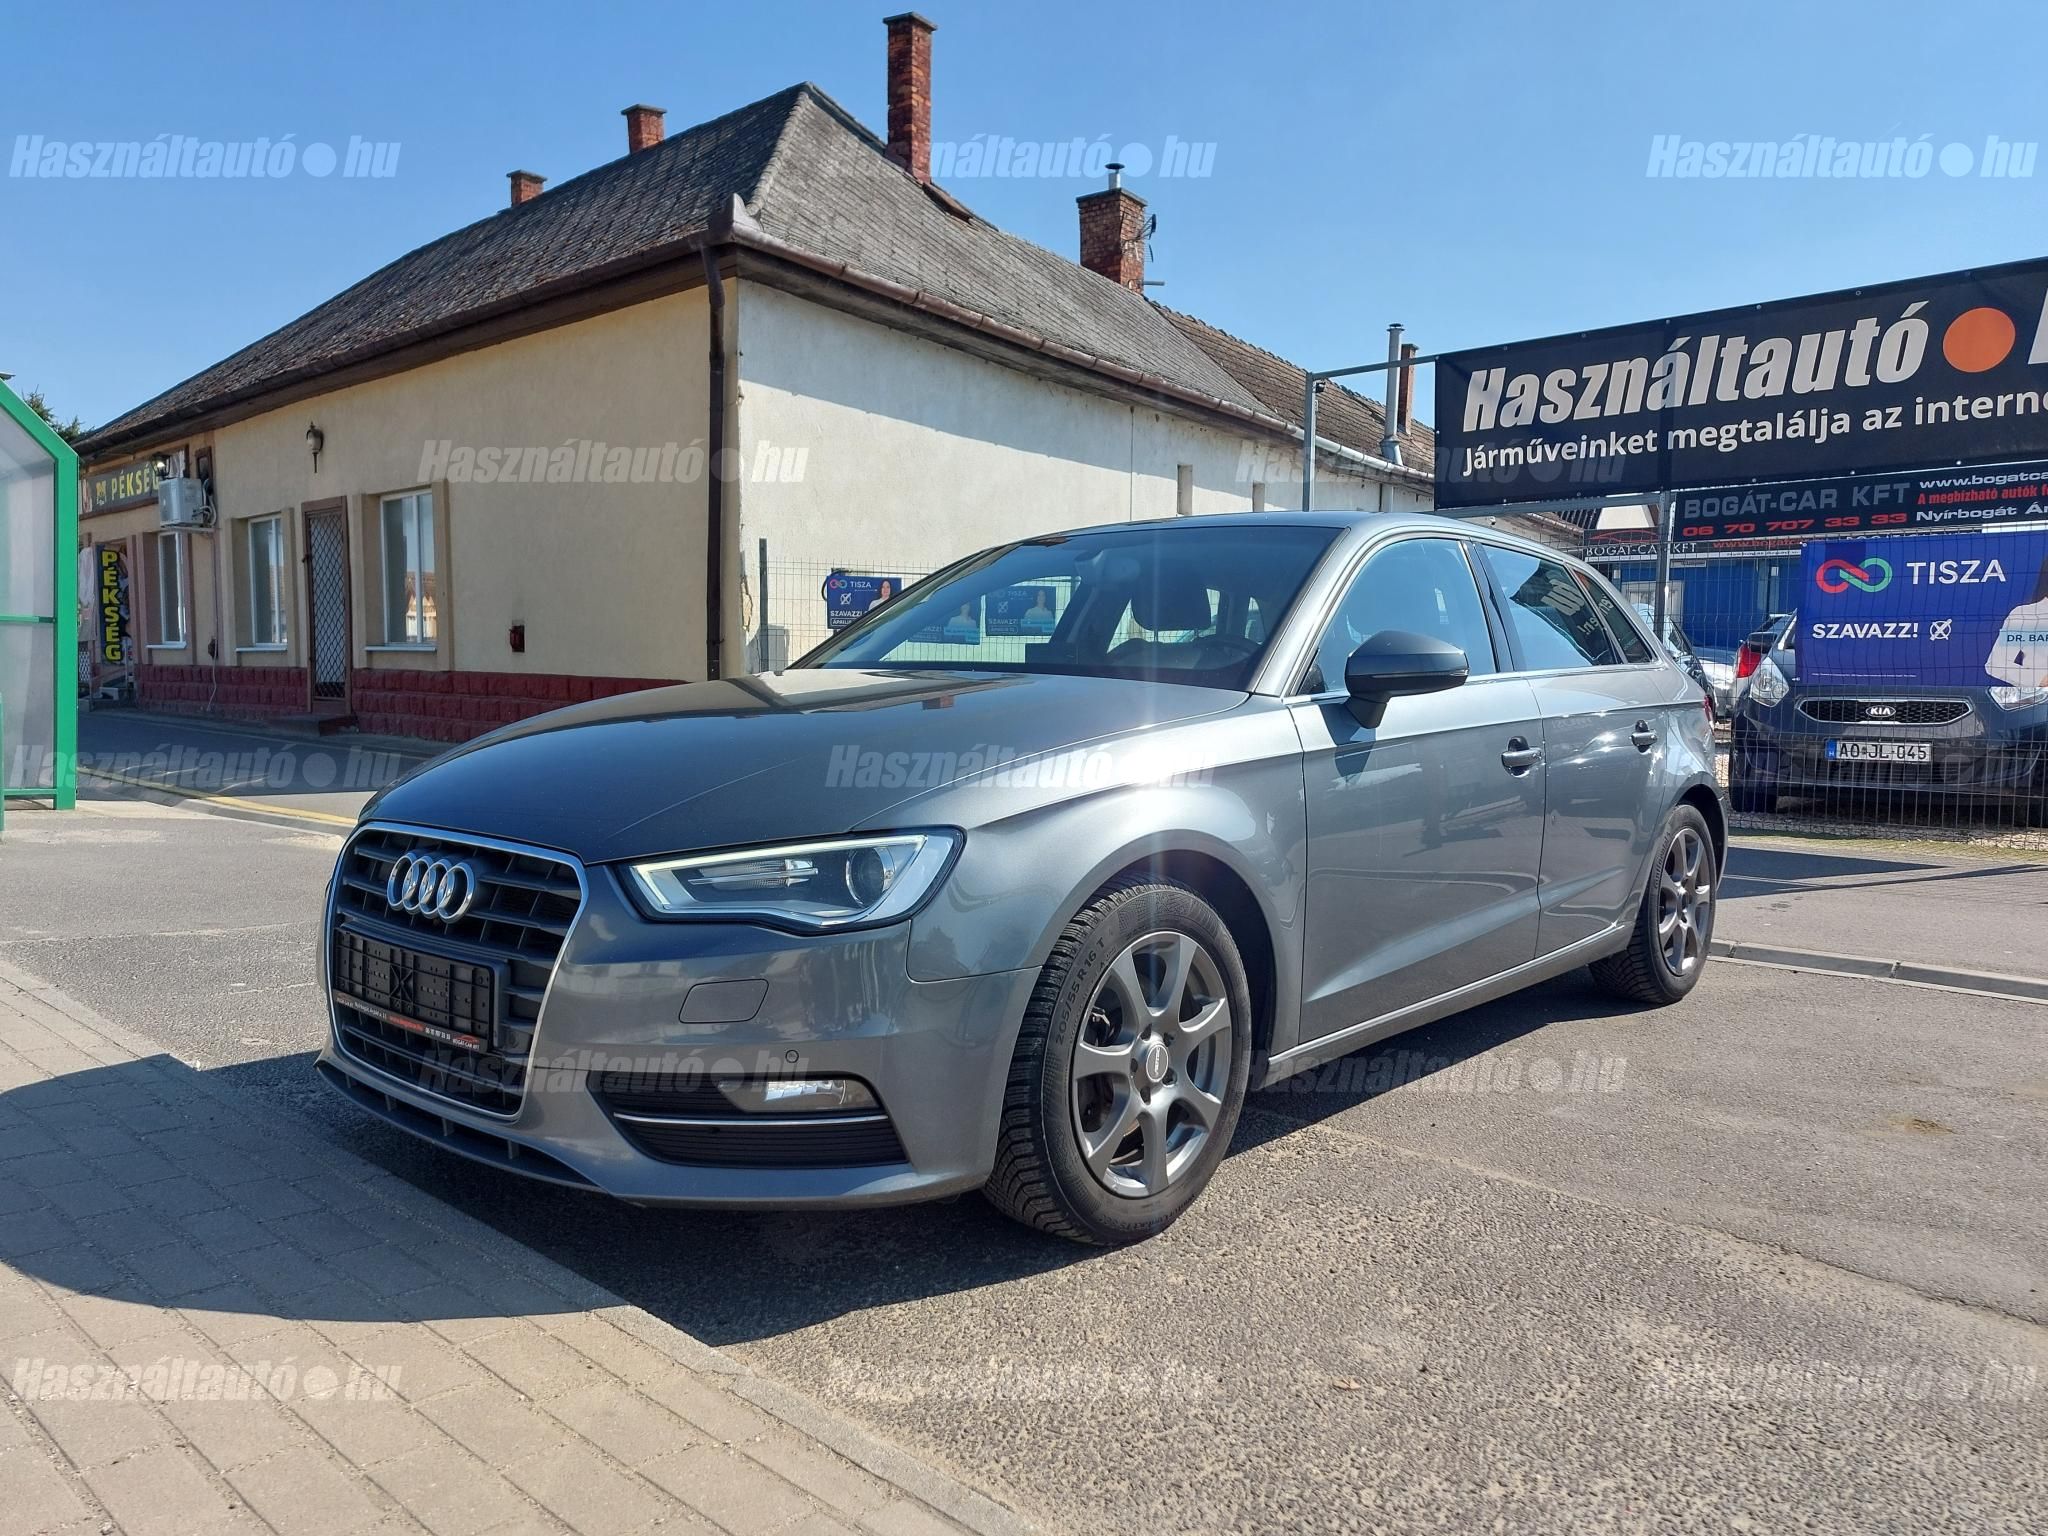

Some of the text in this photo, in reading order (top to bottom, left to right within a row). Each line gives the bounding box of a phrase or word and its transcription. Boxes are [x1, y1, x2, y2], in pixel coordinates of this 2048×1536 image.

[1462, 300, 1930, 432] Használtautó
[1462, 391, 2048, 477] Járműveinket megtalálja az intern
[1684, 482, 1910, 519] BOGÁT-CAR KFT
[1916, 506, 2017, 522] Nyírbogát
[1682, 513, 1907, 537] 06 70 707 33 33
[1673, 542, 1697, 554] KFT
[1906, 559, 2007, 585] TISZA
[1812, 623, 1918, 639] SZAVAZZ!
[2007, 634, 2025, 642] DR.
[1870, 706, 1891, 716] KIA
